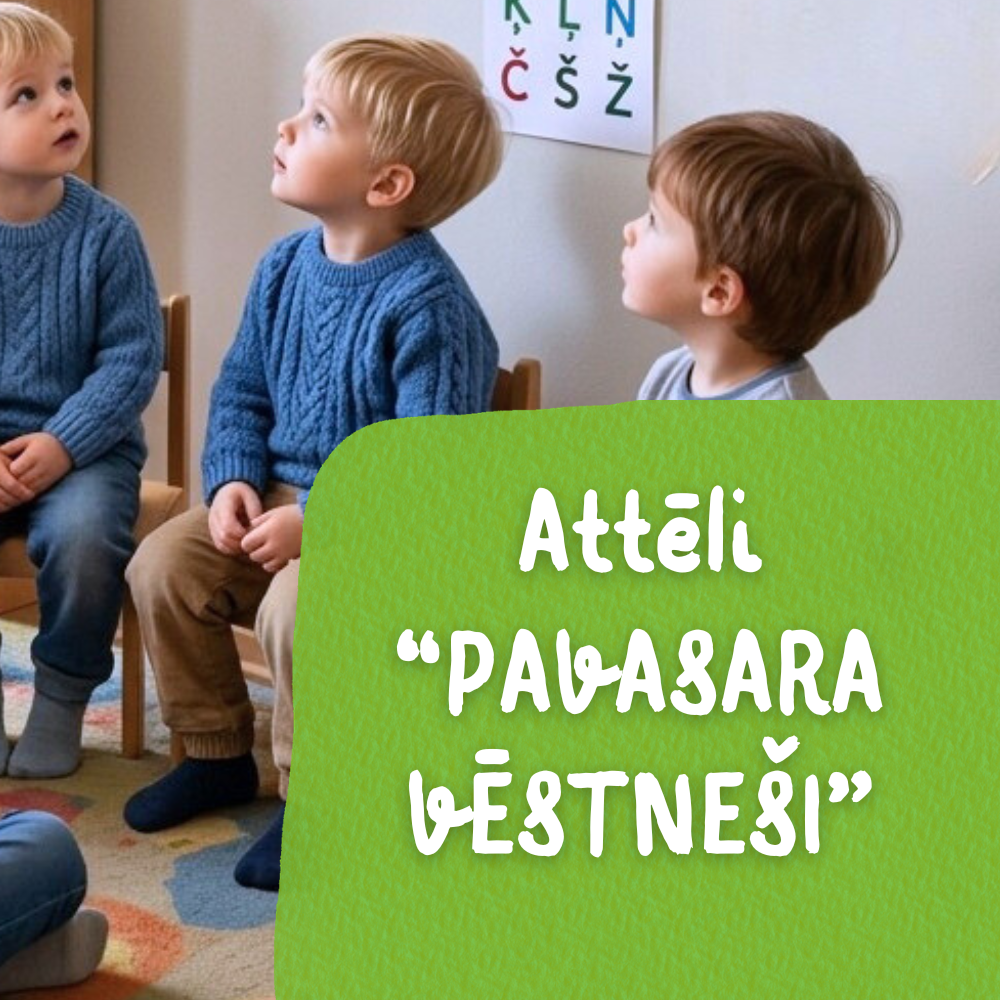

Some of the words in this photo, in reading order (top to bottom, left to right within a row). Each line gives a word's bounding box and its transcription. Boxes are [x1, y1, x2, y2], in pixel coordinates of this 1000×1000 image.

[501, 47, 529, 102] Č
[554, 54, 579, 109] Š
[605, 61, 633, 118] Ž
